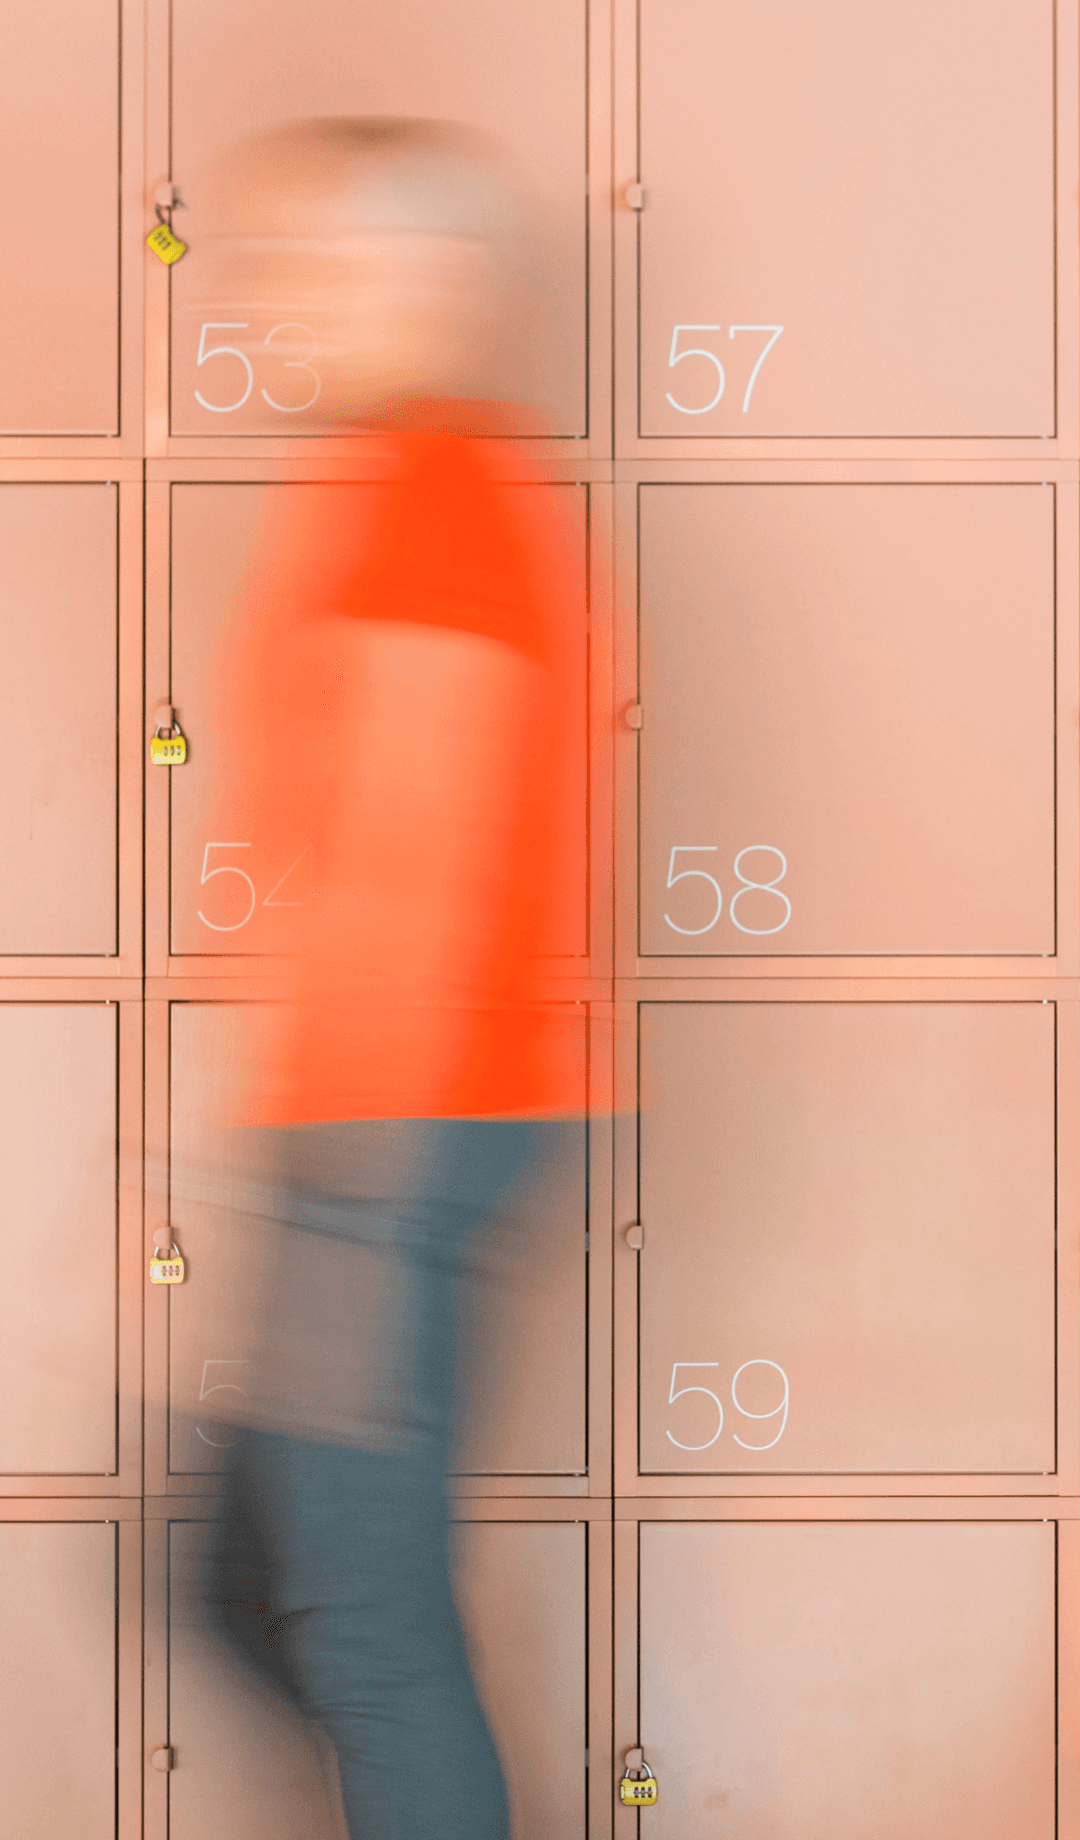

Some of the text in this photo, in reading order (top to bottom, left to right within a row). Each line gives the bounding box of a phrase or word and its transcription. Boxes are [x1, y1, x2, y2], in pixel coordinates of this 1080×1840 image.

[193, 322, 322, 414] 53
[665, 325, 785, 414] 57
[664, 845, 792, 936] 58
[665, 1359, 790, 1451] 59
